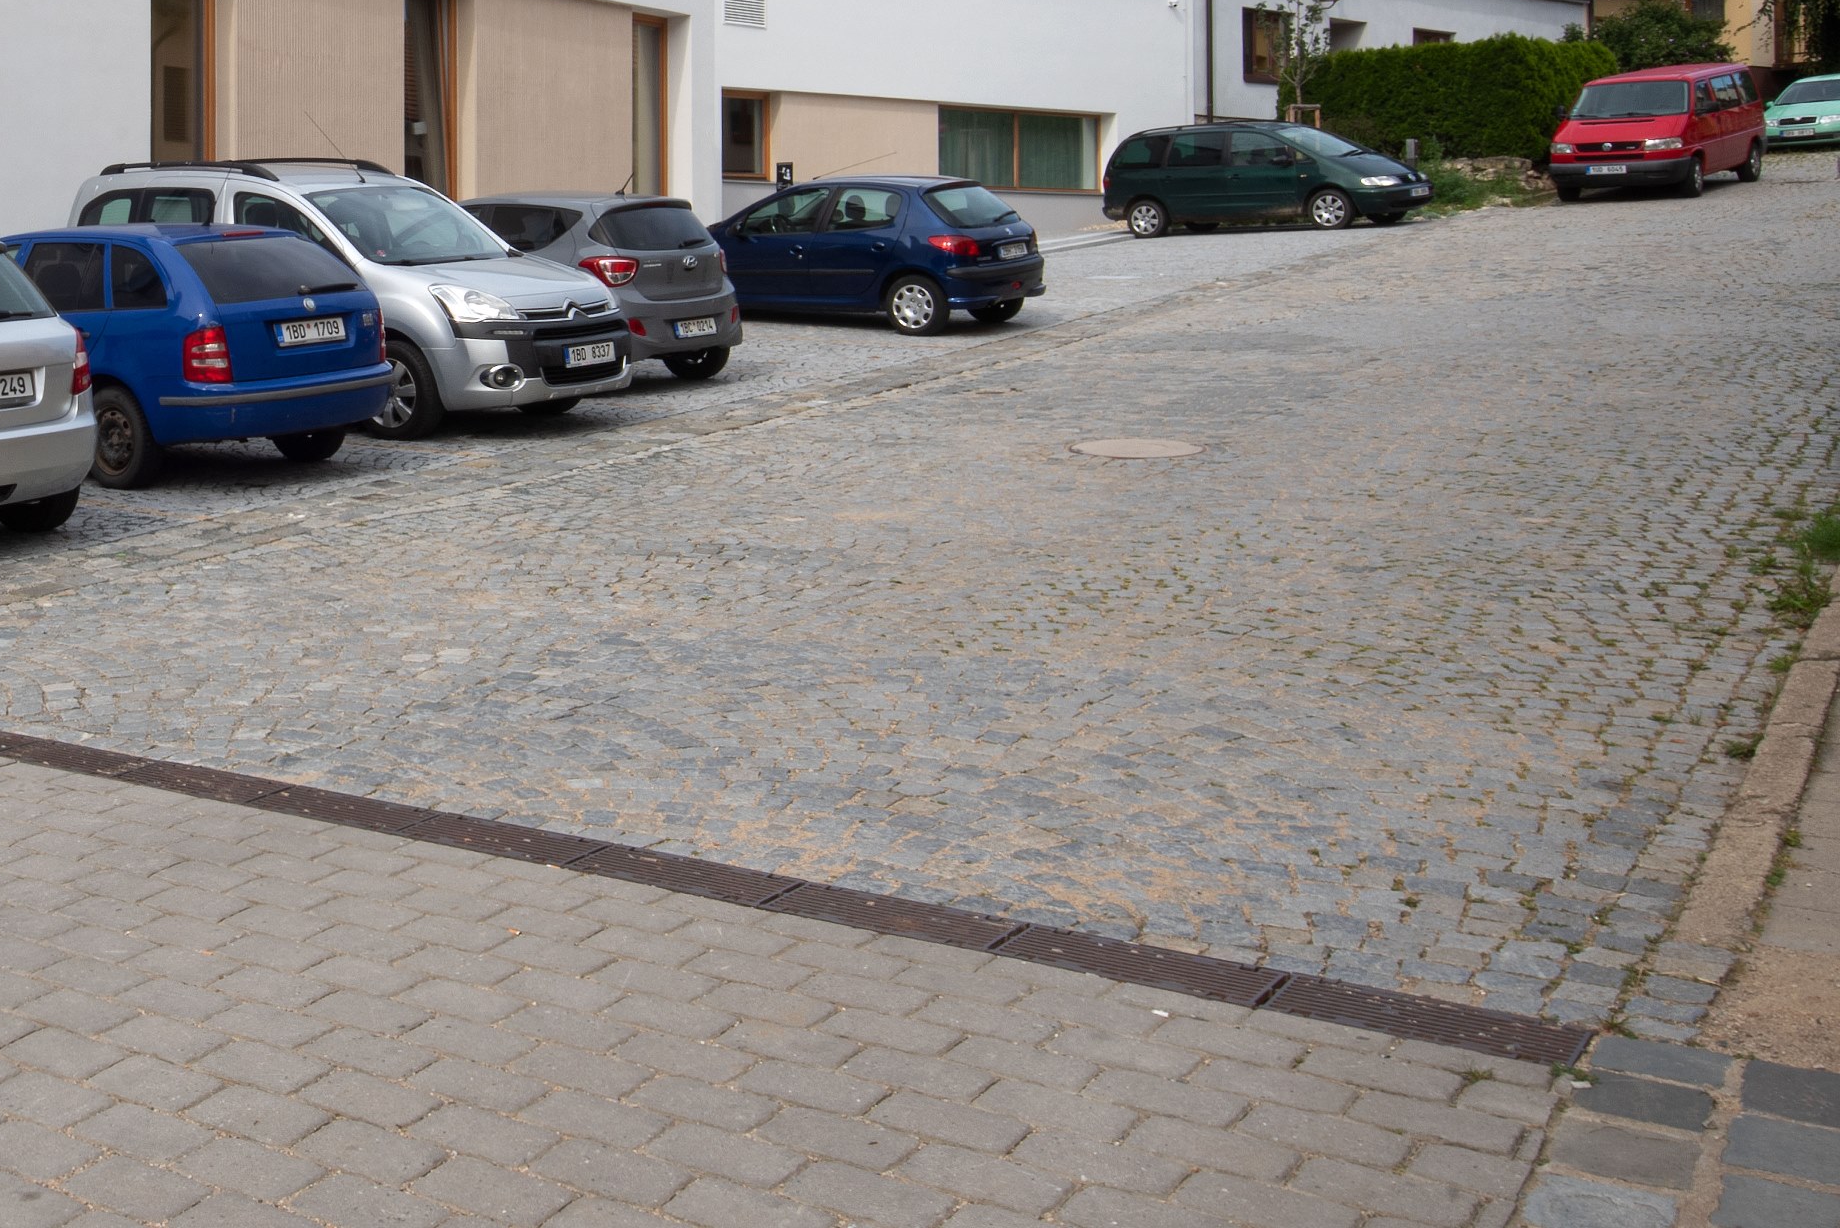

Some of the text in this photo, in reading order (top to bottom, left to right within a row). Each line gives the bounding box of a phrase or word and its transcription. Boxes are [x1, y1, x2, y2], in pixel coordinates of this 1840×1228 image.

[285, 320, 340, 340] 1BD 1709
[696, 319, 714, 332] 0214
[571, 343, 610, 362] 1BD 8337
